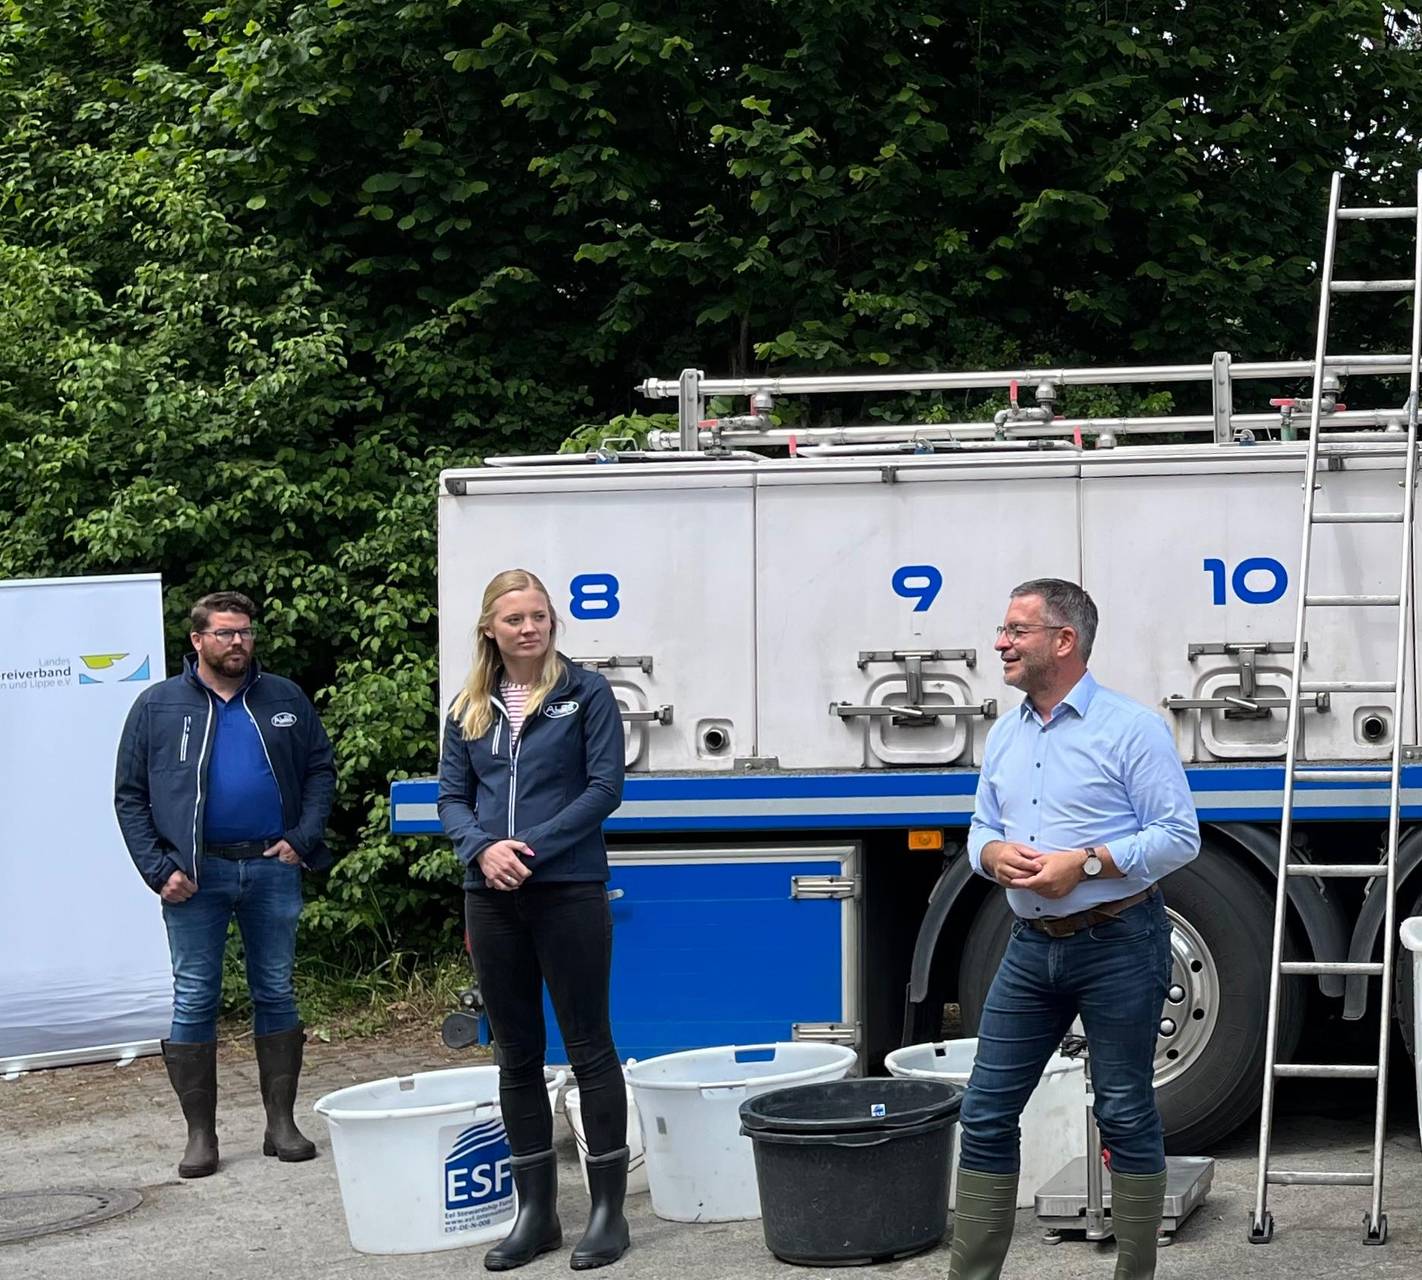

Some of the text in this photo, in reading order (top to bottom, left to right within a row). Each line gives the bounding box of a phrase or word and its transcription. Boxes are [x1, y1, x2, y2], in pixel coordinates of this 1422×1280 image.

[570, 573, 620, 620] 8
[892, 565, 943, 612] 9
[1203, 557, 1288, 605] 10
[0, 666, 71, 680] reiverband
[9, 680, 27, 689] und
[30, 679, 55, 689] Lippe
[447, 1159, 511, 1202] ESF
